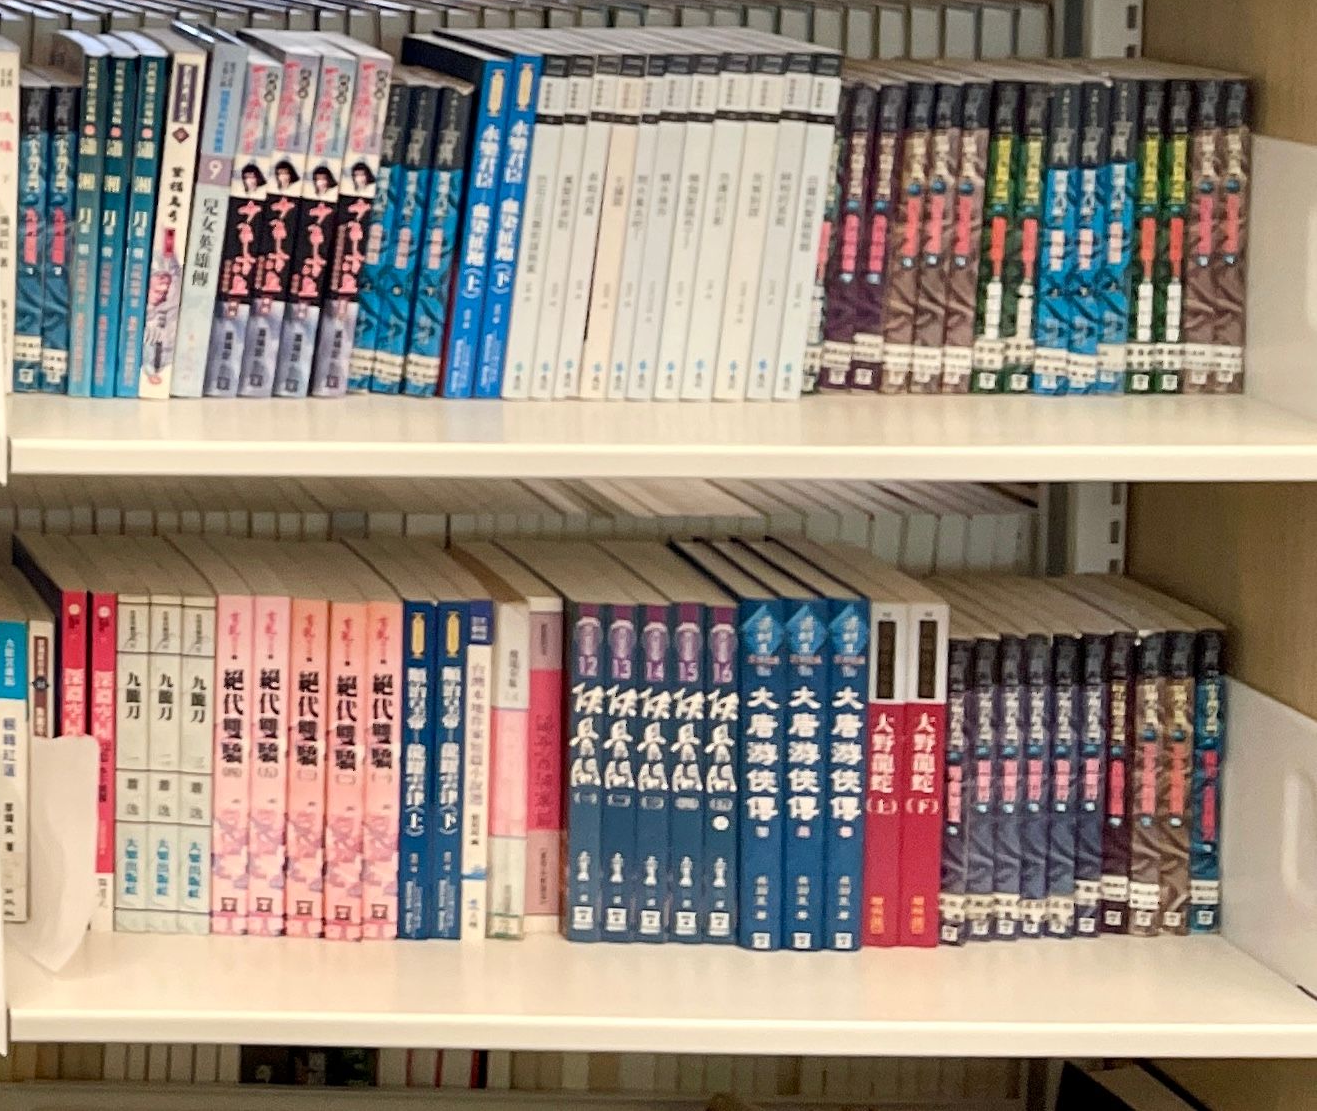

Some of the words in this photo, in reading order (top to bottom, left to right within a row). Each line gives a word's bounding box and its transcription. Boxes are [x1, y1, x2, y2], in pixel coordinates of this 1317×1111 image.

[209, 162, 223, 180] 9
[191, 197, 219, 287] 兒女英雄傳
[579, 656, 598, 676] 12
[613, 658, 632, 678] 13
[646, 661, 664, 681] 14
[679, 661, 698, 682] 15
[713, 662, 732, 683] 16
[220, 669, 244, 765] 絕代雙驕
[257, 668, 280, 764] 絕代雙驕
[295, 671, 320, 767] 絕代雙驕
[335, 675, 358, 772] 絕代雙驕
[370, 673, 394, 770] 絕代雙驕
